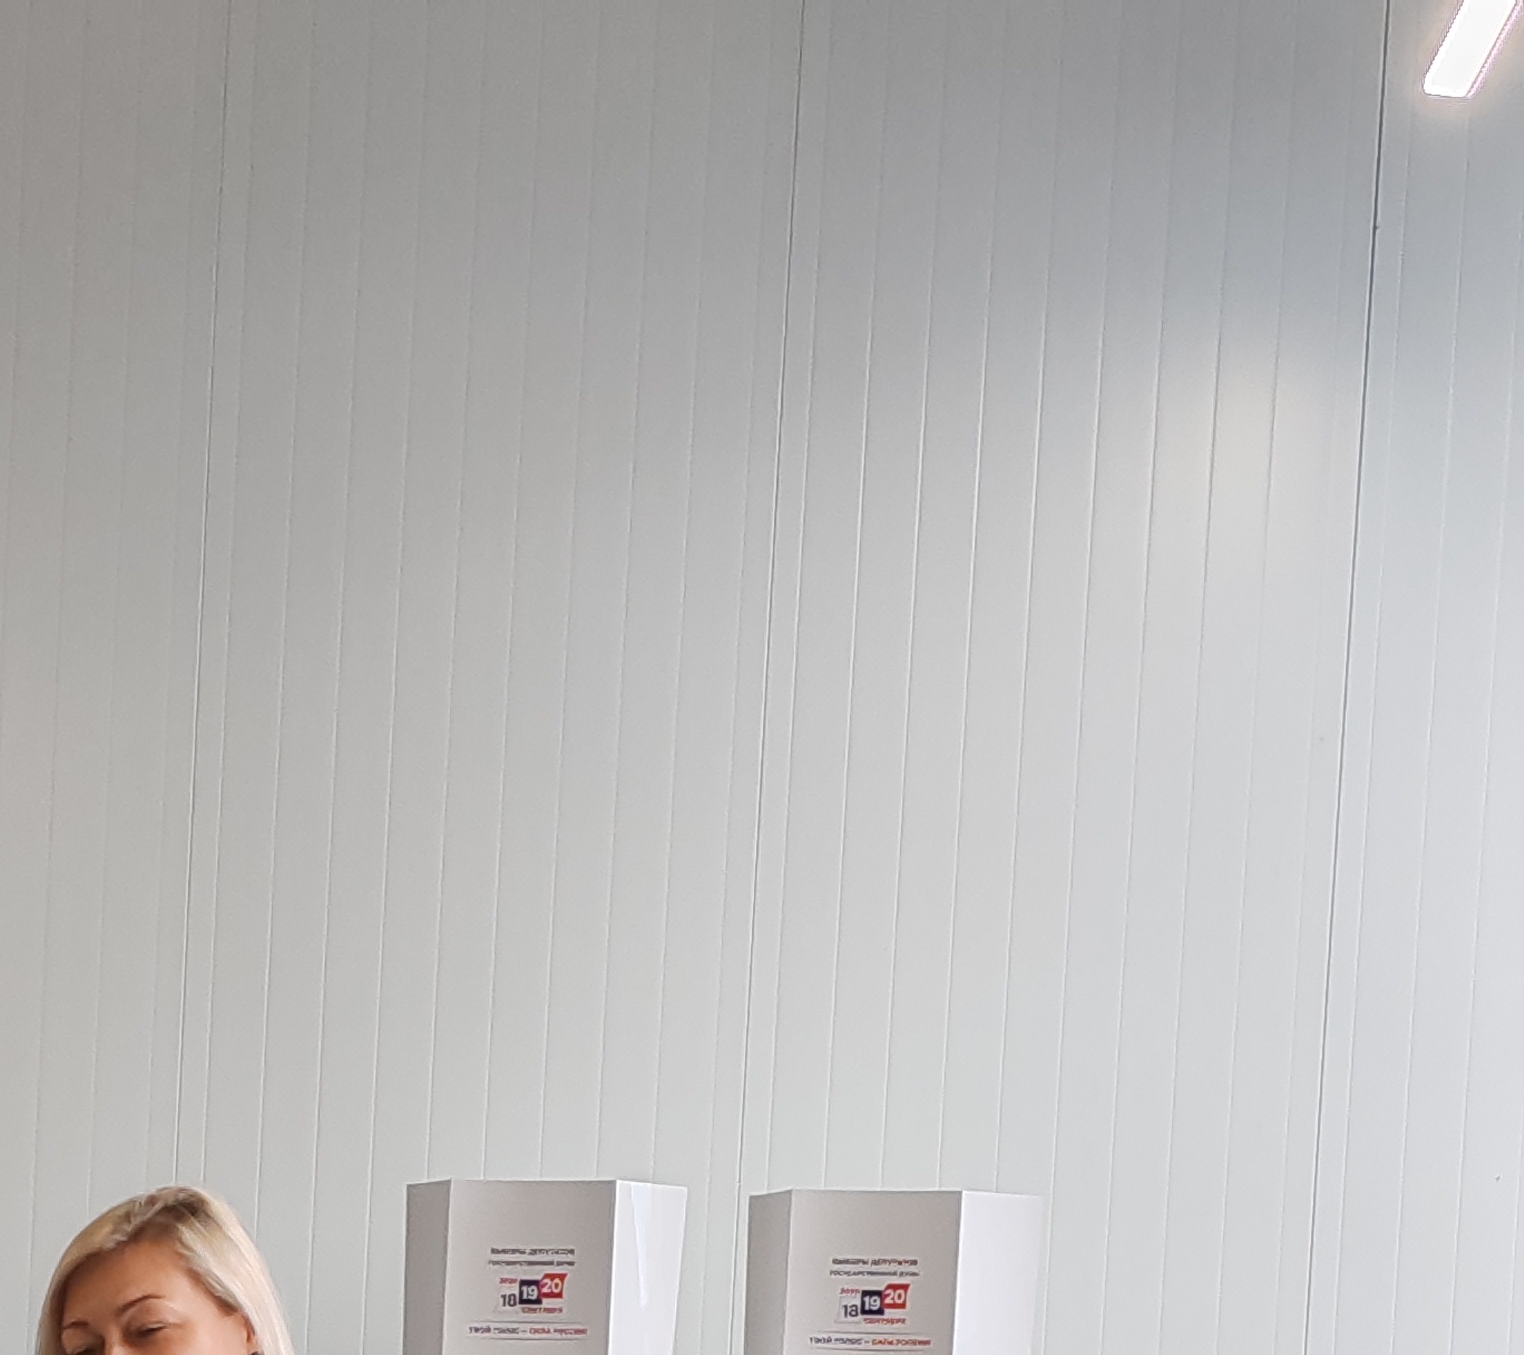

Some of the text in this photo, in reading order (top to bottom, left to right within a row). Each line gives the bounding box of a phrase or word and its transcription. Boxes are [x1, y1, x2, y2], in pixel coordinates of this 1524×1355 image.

[521, 1285, 538, 1300] 19
[541, 1278, 562, 1293] 20
[501, 1293, 517, 1308] 18
[863, 1296, 881, 1311] 19
[884, 1289, 905, 1304] 20
[842, 1304, 859, 1318] 18
